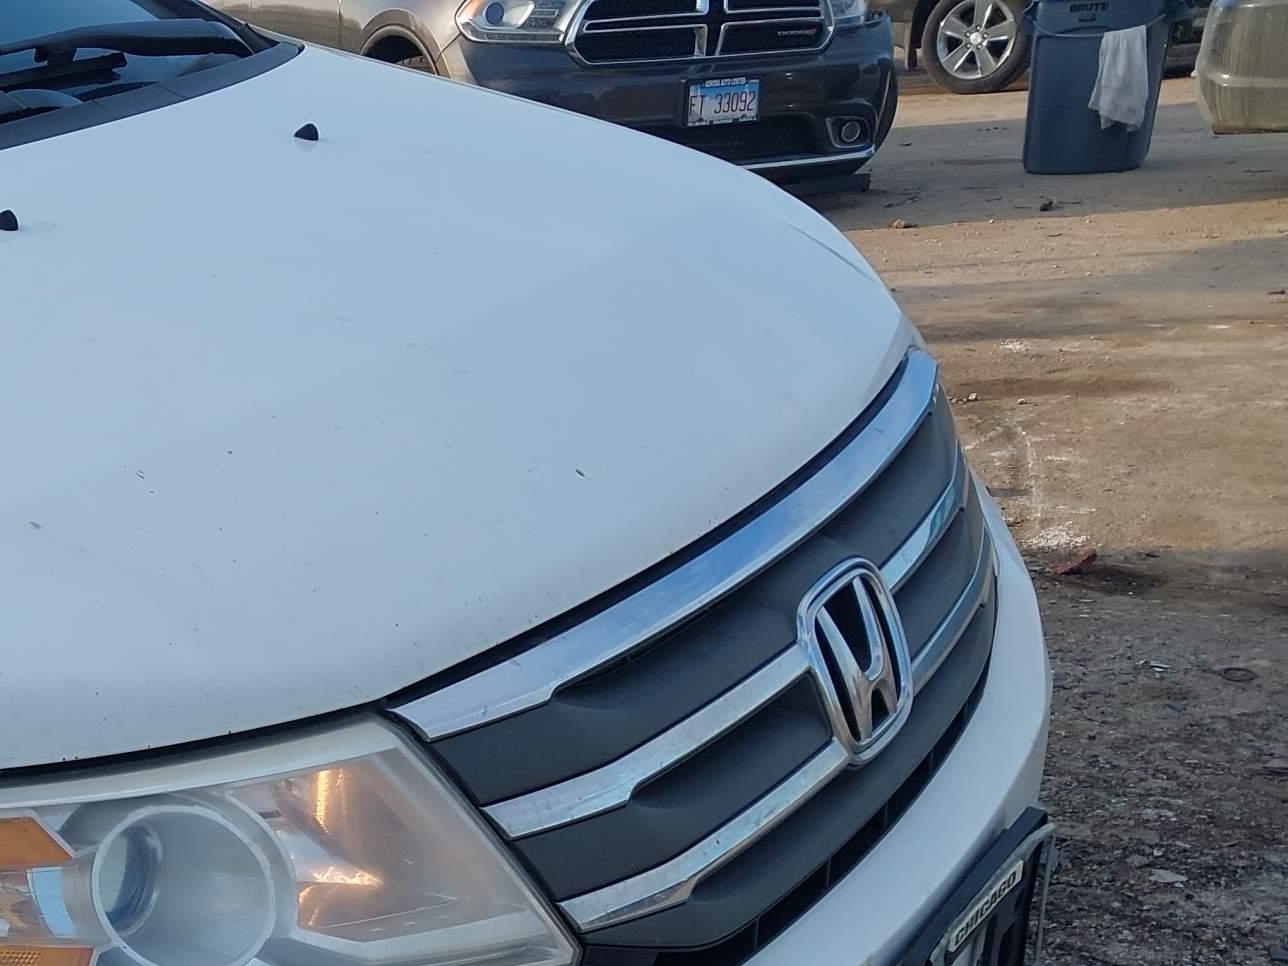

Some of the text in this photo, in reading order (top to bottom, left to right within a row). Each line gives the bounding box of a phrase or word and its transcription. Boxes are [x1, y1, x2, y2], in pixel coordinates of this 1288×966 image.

[1069, 2, 1109, 13] BRUTE
[713, 90, 756, 114] 33092
[954, 870, 1017, 946] CHICAGO
